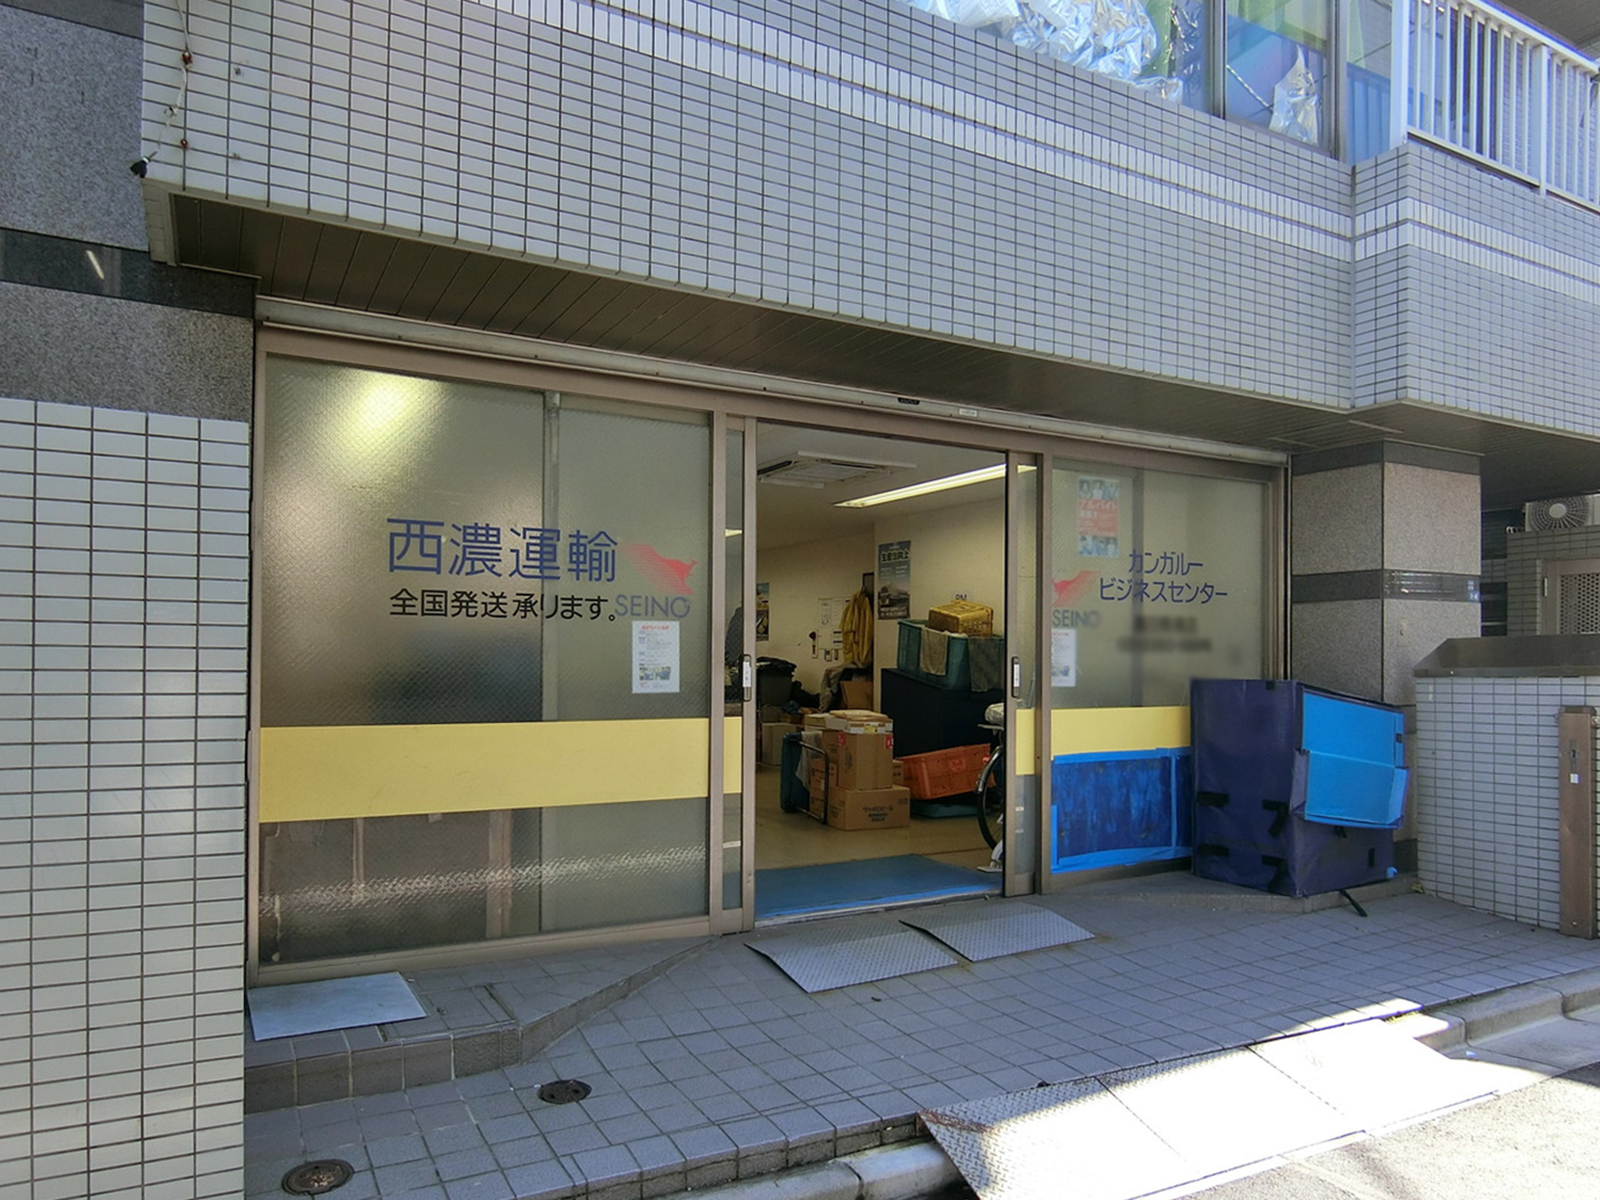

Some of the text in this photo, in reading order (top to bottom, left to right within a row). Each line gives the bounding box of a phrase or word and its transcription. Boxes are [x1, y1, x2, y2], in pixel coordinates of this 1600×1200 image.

[387, 518, 618, 583] 西濃運輸
[1128, 550, 1203, 576] カンガルー
[1100, 578, 1228, 604] ビジネスセンター
[390, 588, 616, 622] 全国発送承ります。
[614, 594, 691, 618] SEINO
[1052, 609, 1101, 629] SEINO
